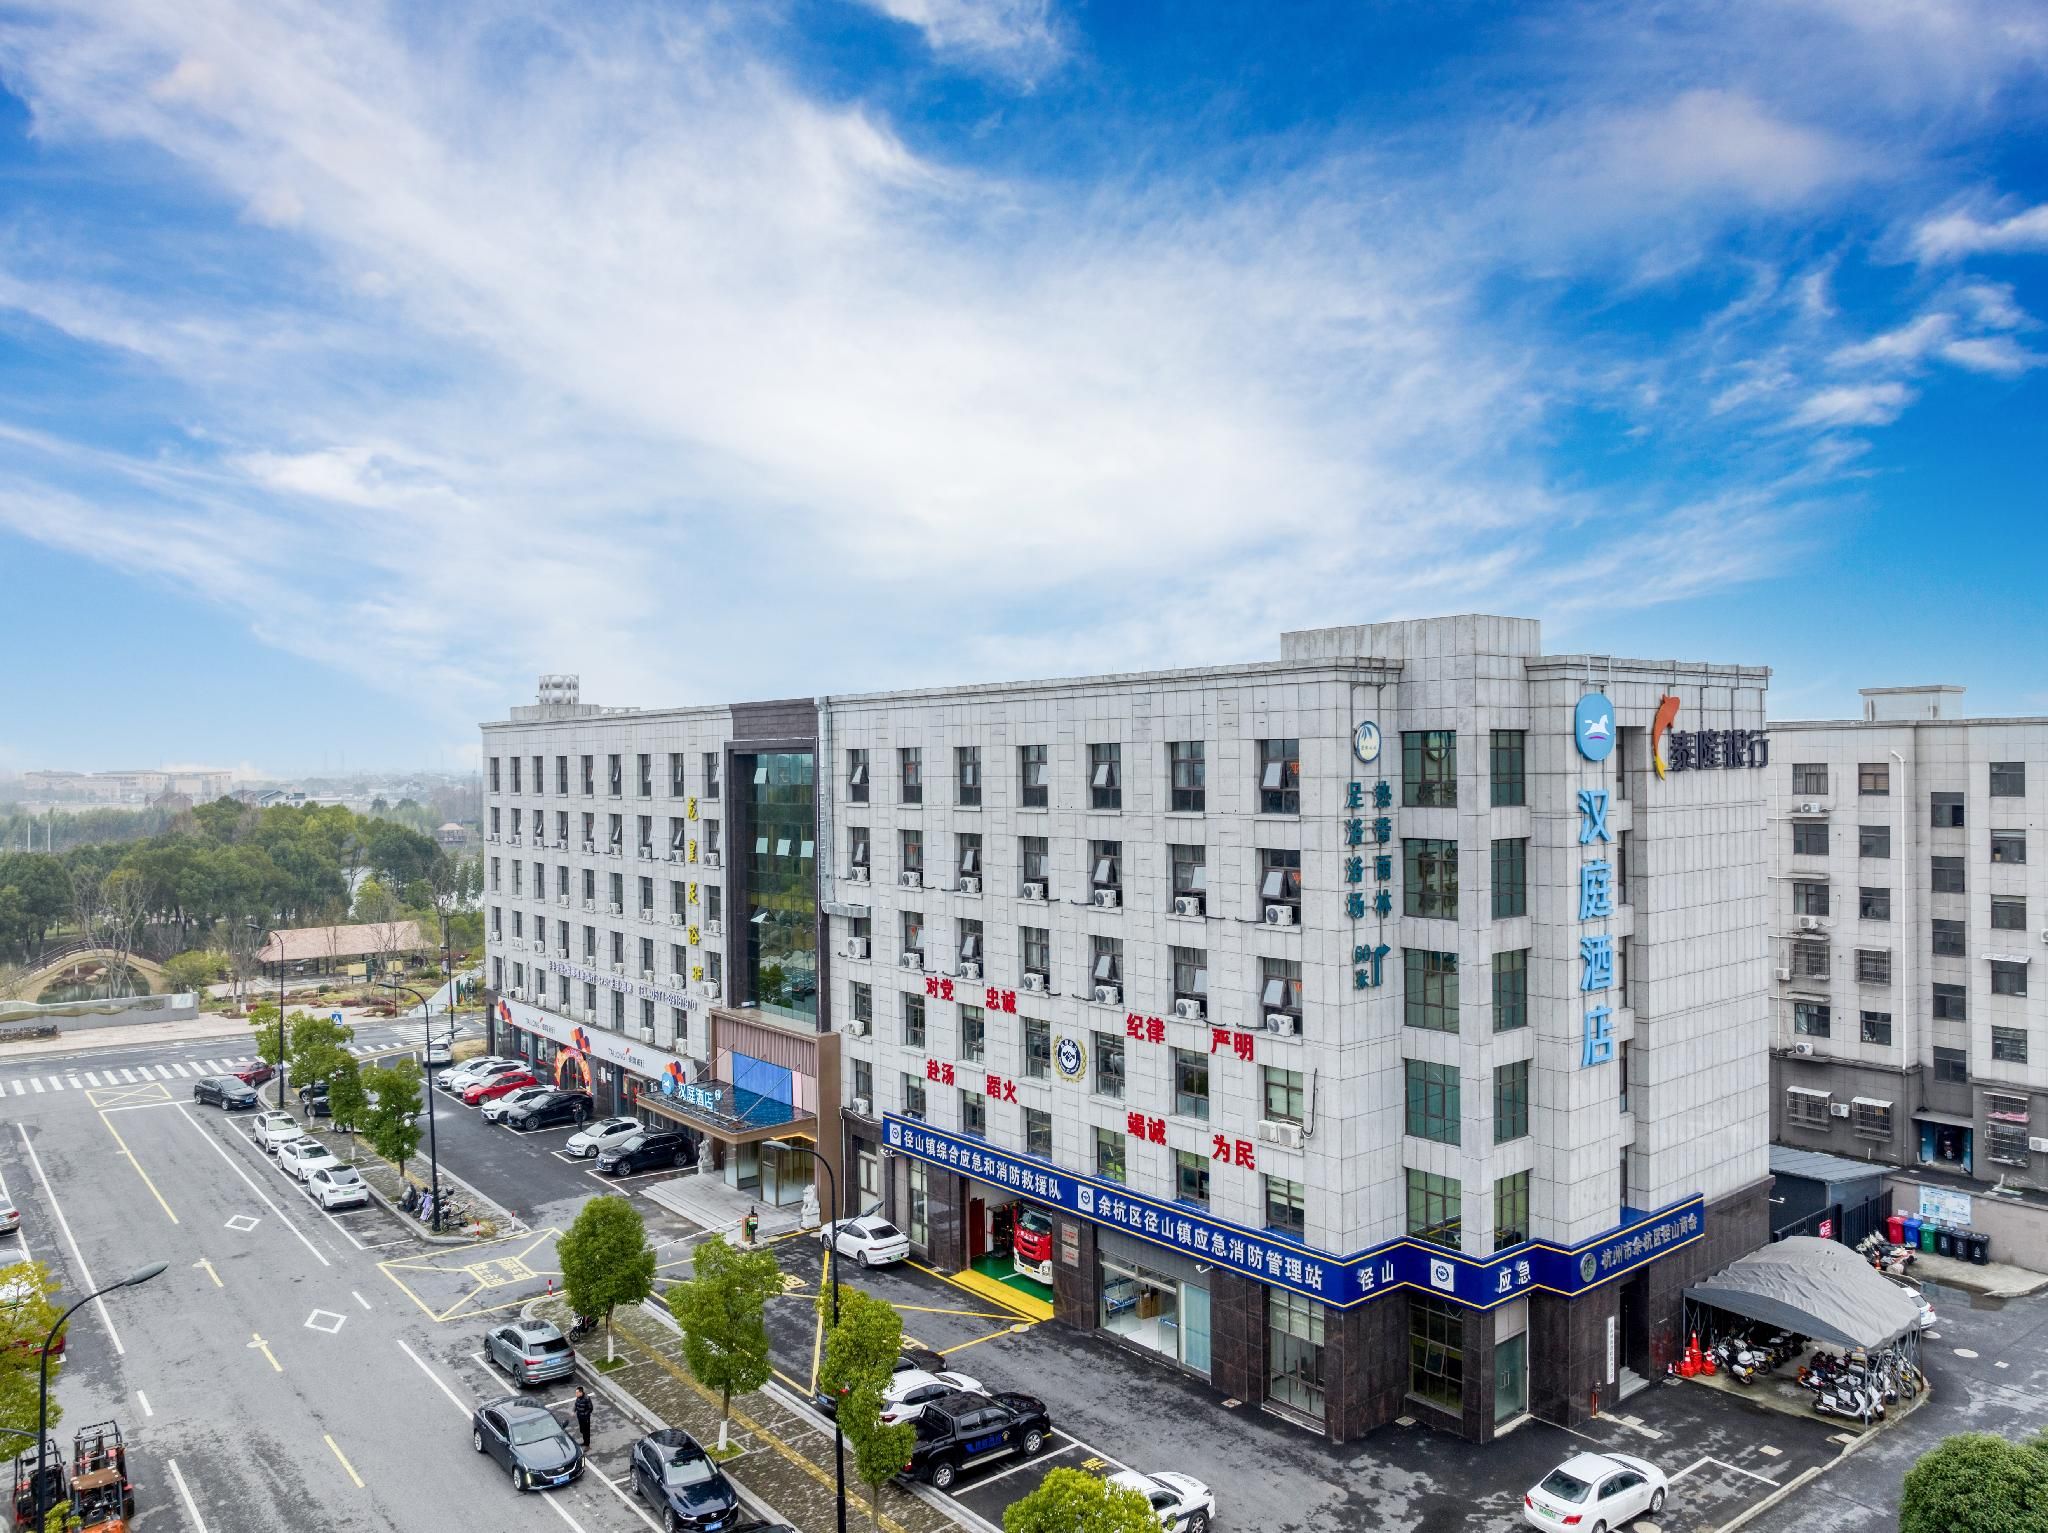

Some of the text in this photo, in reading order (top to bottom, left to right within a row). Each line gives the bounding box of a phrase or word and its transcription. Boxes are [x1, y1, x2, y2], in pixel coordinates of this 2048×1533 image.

[1671, 728, 1770, 771] 泰隆银行
[1577, 789, 1615, 1068] 汉庭酒店
[1355, 969, 1370, 990] 米
[925, 976, 1255, 1062] 对党 忠诚 纪律 严明
[678, 1083, 714, 1110] 汉庭酒店
[926, 1059, 1256, 1171] 赴汤 蹈火 竭诚 为民
[903, 1129, 1062, 1201] 径山镇综合应急和消防救援队
[1097, 1195, 1323, 1291] 余杭区径山镇应急消防管理站
[1601, 1212, 1698, 1271] 杭州市余杭区径山商会
[1357, 1260, 1531, 1294] 径山 应急
